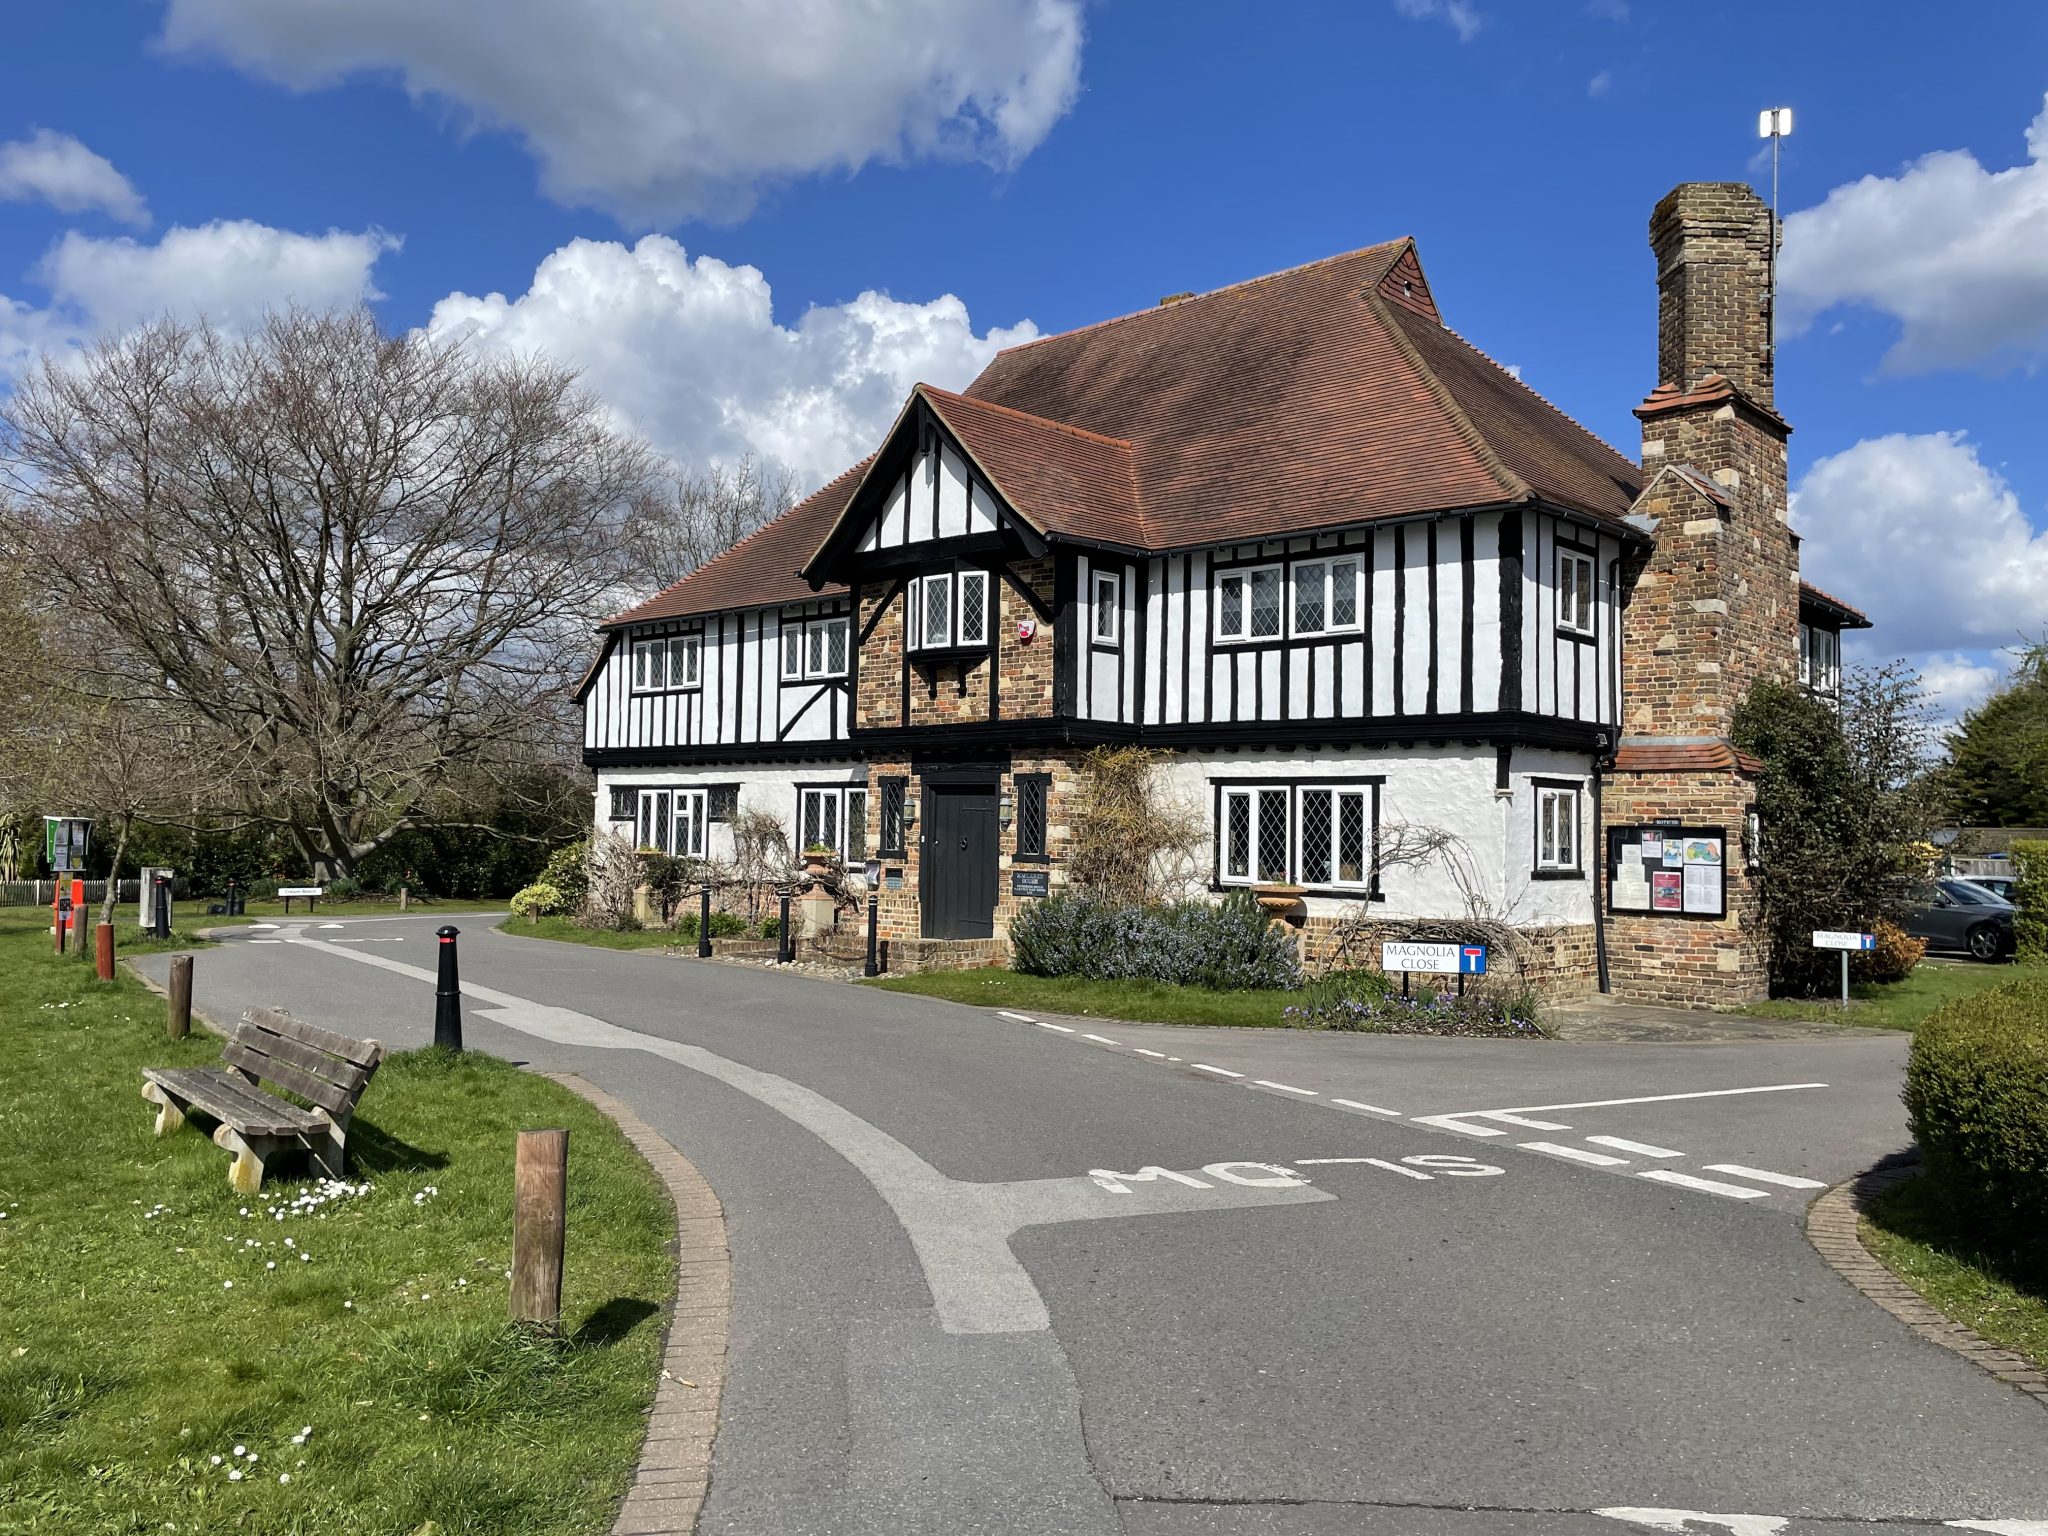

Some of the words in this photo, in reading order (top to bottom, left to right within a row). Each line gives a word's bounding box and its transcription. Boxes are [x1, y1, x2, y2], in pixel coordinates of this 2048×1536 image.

[1386, 944, 1455, 957] MAGNOLIA
[1401, 958, 1440, 970] CLOSE
[1088, 1154, 1506, 1194] SLOW
